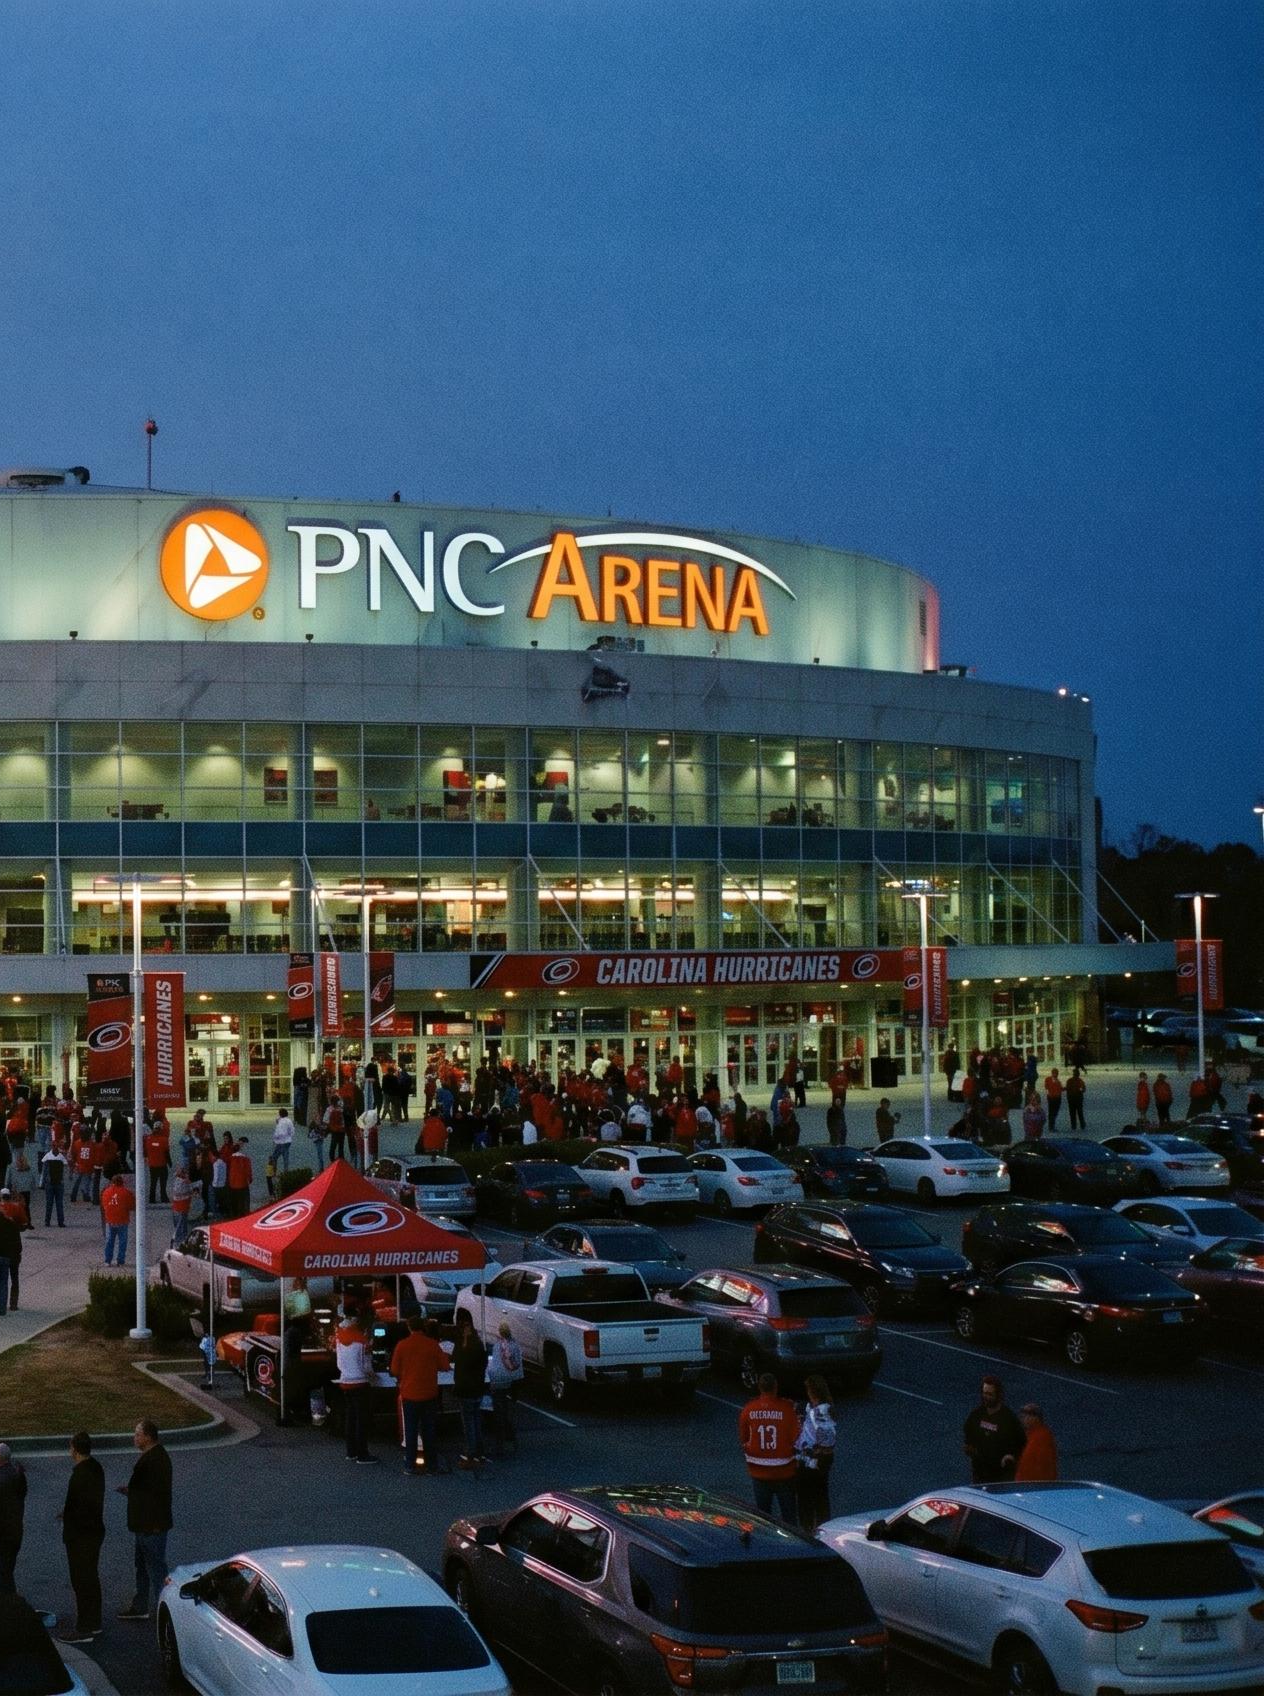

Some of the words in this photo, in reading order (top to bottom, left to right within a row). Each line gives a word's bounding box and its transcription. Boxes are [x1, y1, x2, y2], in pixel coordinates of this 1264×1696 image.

[287, 525, 505, 616] PNC
[527, 532, 771, 636] ARENA
[596, 956, 706, 985] CAROLINA
[713, 955, 841, 982] HURRICANES
[156, 980, 173, 1086] HURRICANES
[304, 1252, 371, 1269] CAROLINA
[374, 1250, 459, 1266] HURRICANES
[757, 1425, 777, 1449] 13
